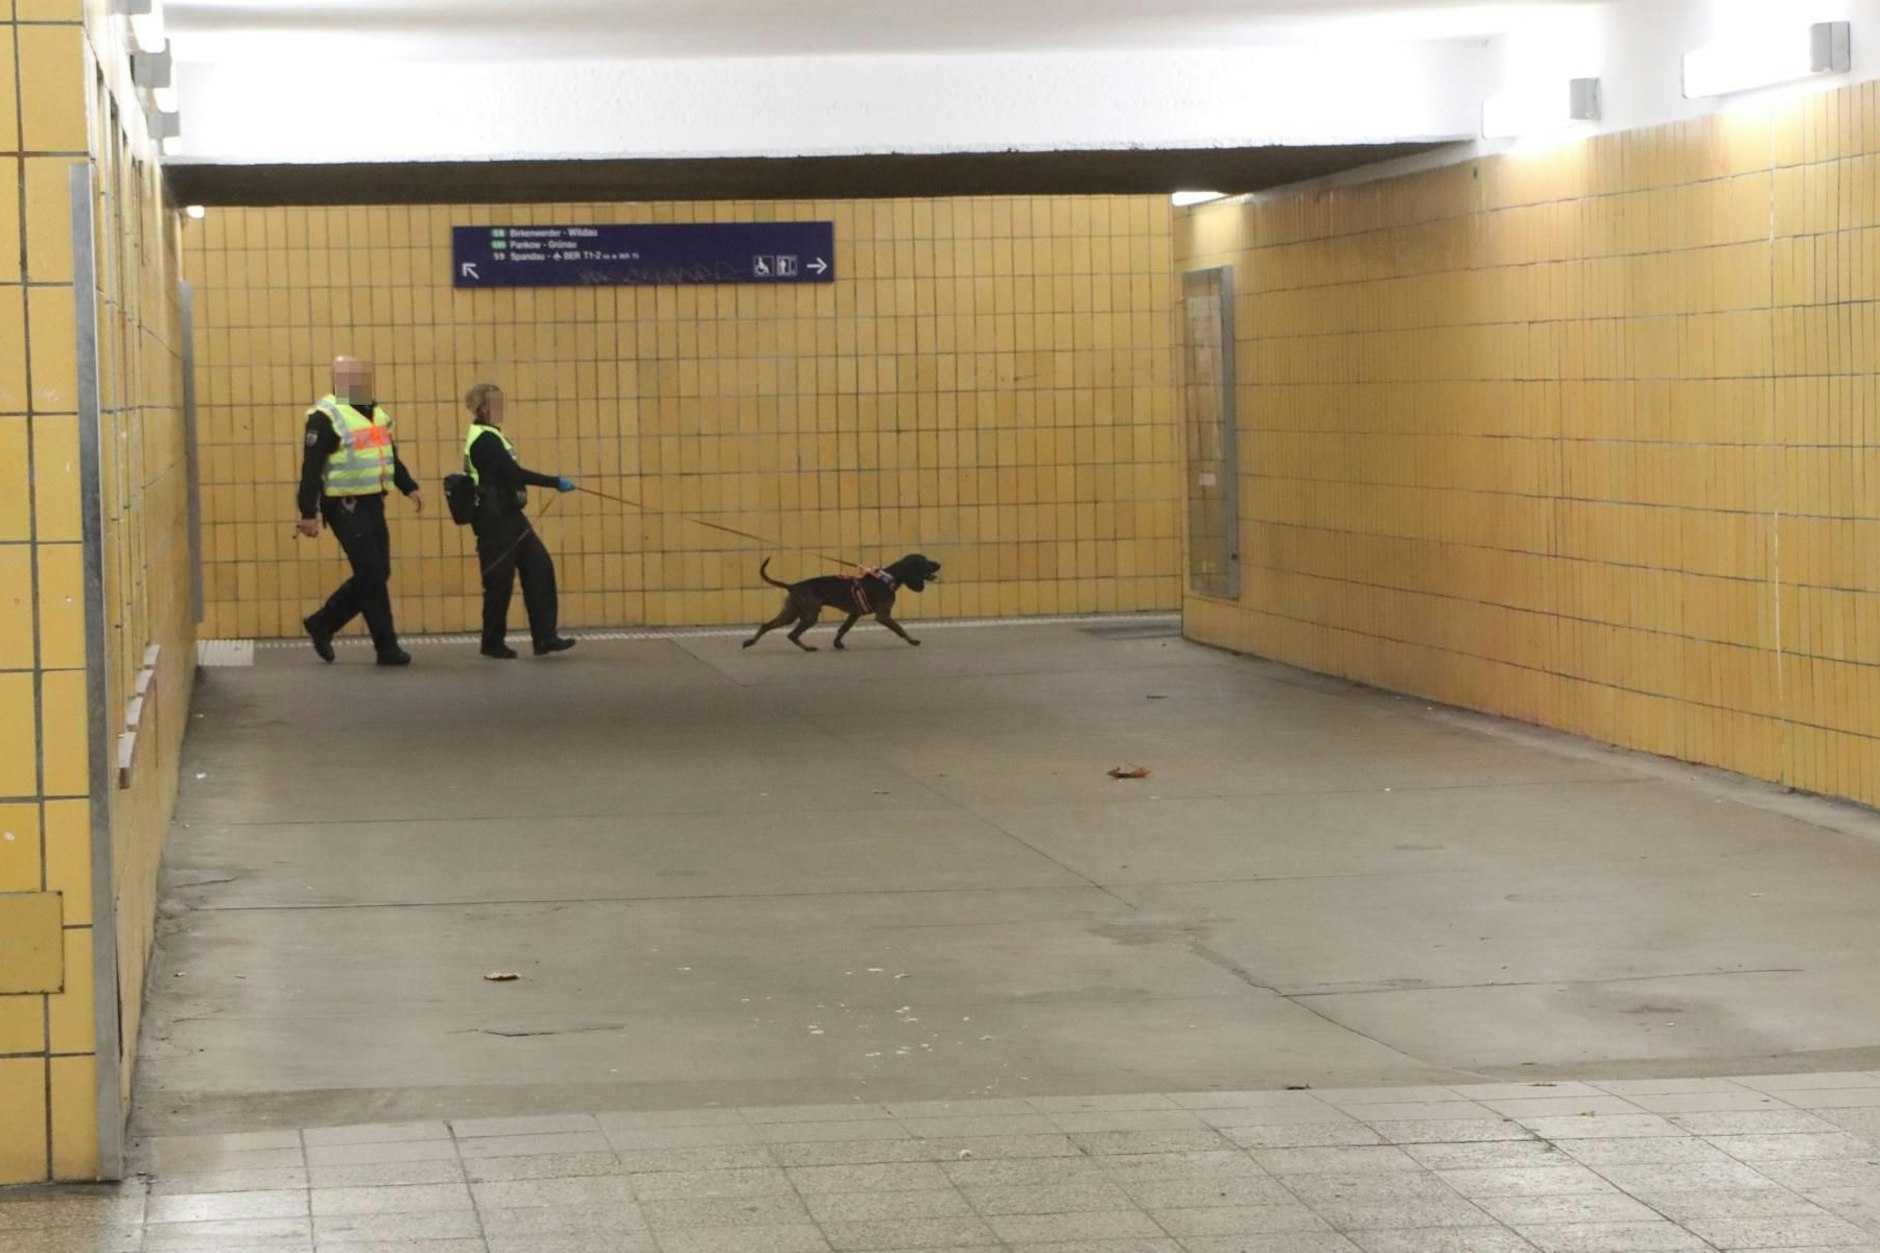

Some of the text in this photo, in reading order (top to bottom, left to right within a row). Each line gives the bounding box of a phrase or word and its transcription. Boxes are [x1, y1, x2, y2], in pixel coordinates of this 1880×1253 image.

[568, 228, 598, 237] Wildau
[510, 241, 541, 249] Pankow
[548, 240, 577, 249] Grünau
[510, 252, 546, 262] Spandau
[563, 251, 581, 260] BER
